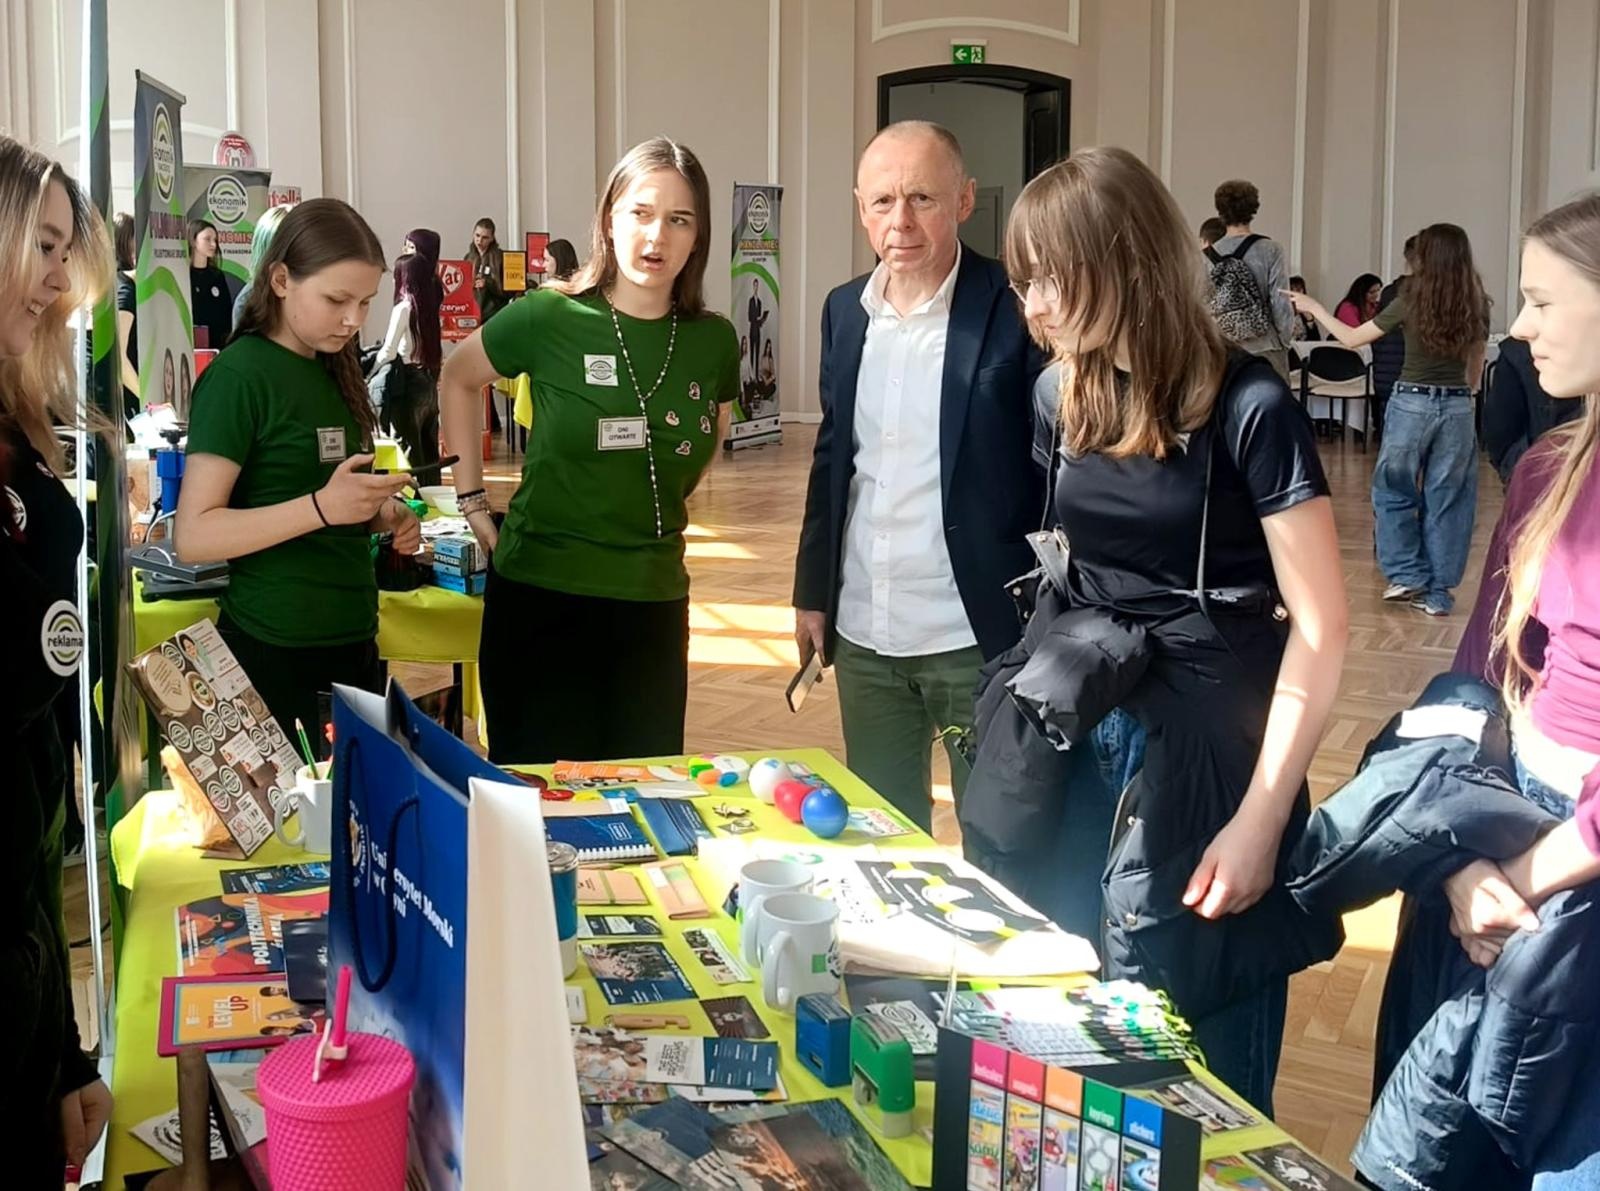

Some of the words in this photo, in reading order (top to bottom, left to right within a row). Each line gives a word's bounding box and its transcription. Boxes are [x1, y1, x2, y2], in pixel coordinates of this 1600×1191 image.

[48, 632, 83, 648] reklama
[242, 897, 272, 965] POLITECHNIKA
[422, 894, 454, 948] Morski
[229, 995, 249, 1012] UP
